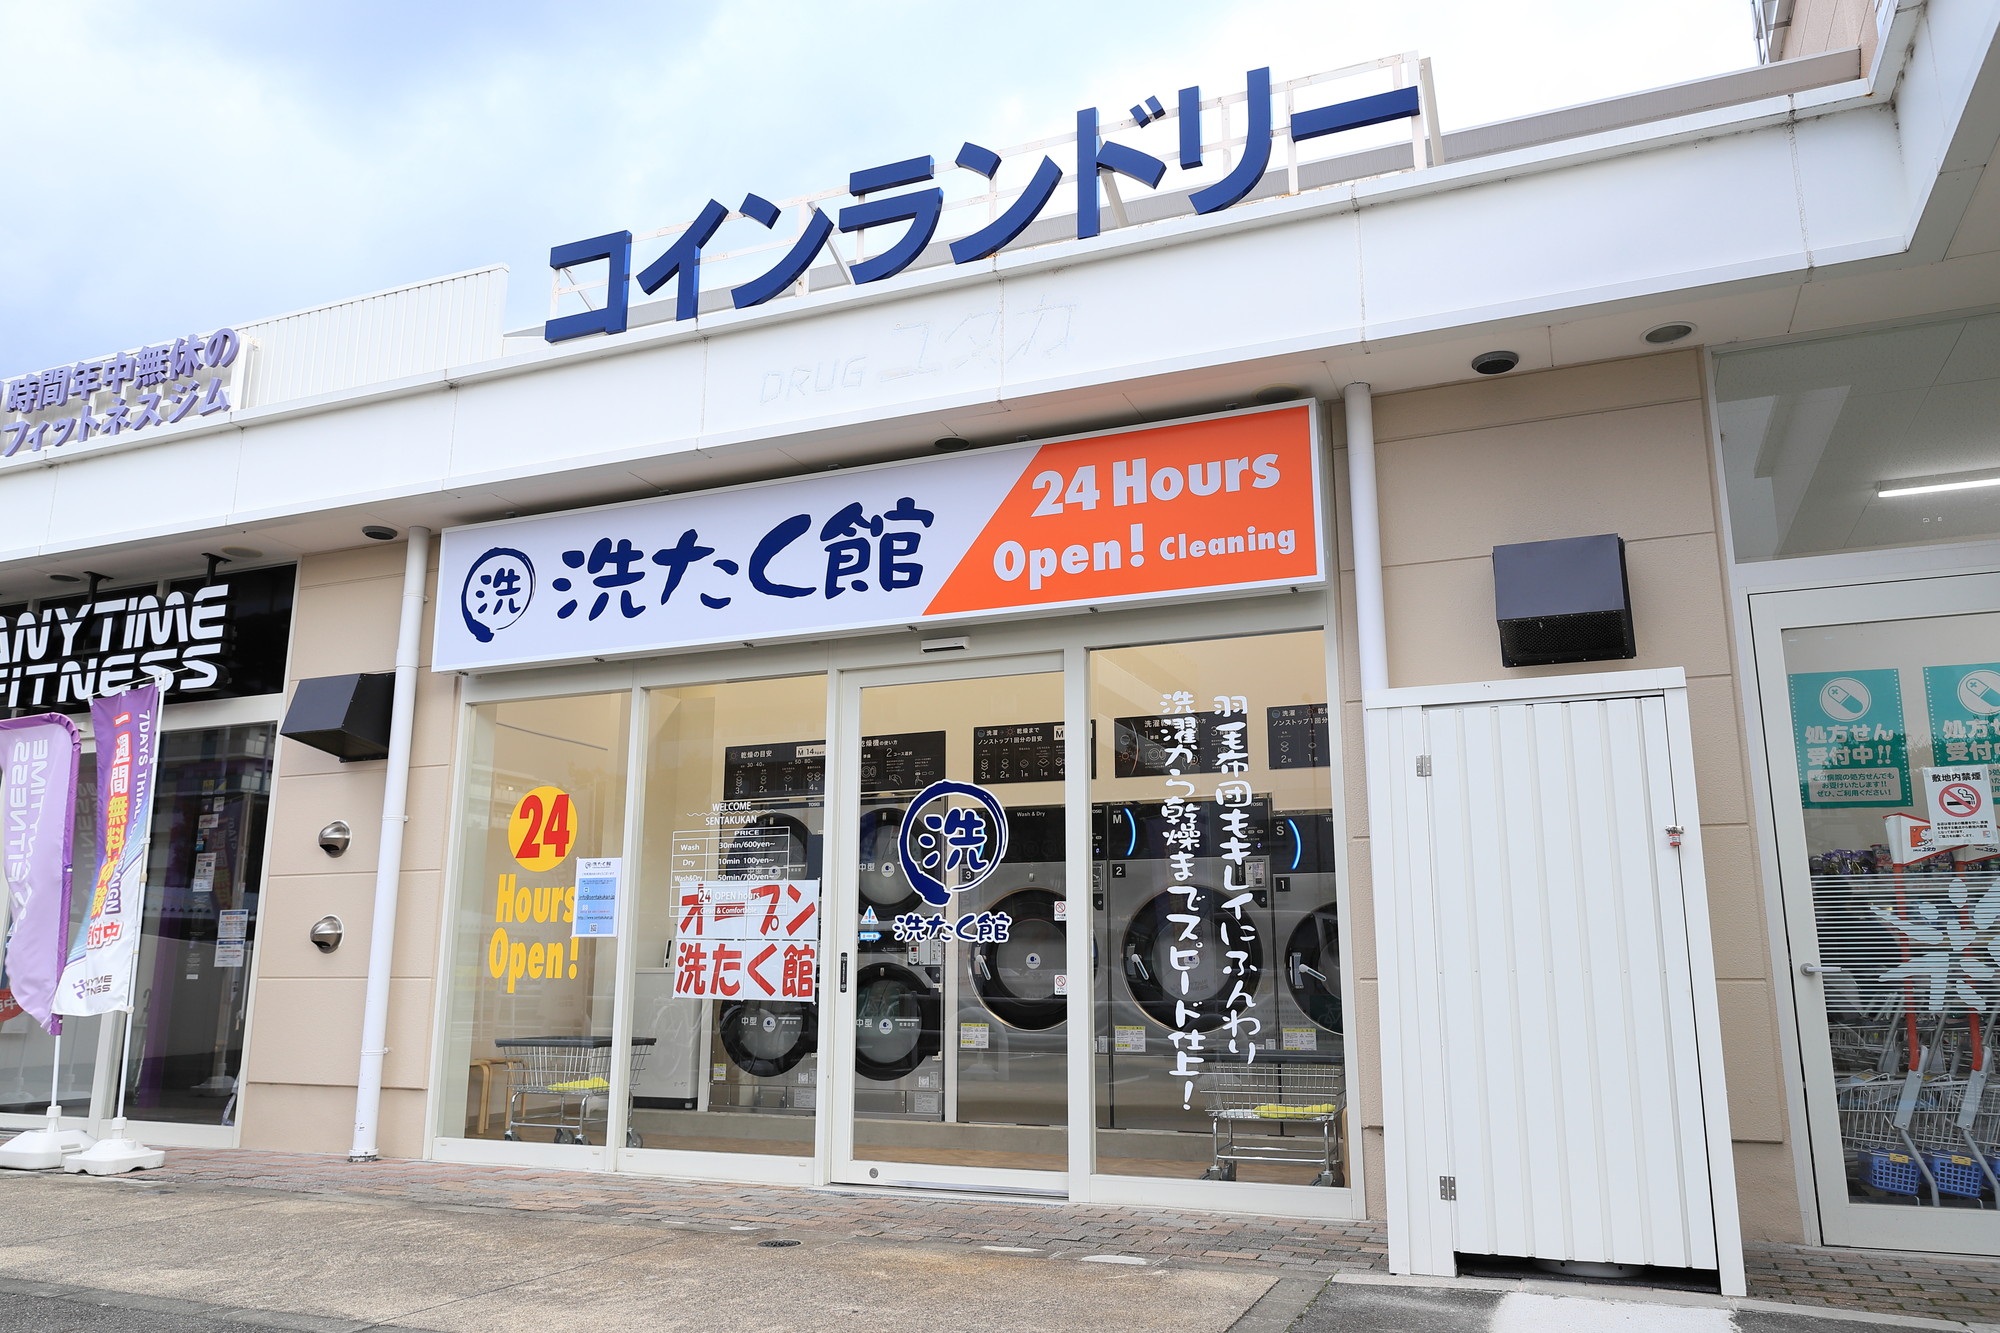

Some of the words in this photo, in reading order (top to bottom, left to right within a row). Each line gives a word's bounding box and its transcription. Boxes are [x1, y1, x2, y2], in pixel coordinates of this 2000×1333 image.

[545, 66, 1420, 342] コインランドリー
[0, 327, 240, 414] 時間年中無休の
[3, 377, 231, 457] フィットネスジム
[1031, 465, 1100, 517] 24
[1113, 453, 1281, 507] Hours
[552, 497, 935, 622] 洗たく館
[993, 523, 1144, 590] Open!
[1159, 526, 1296, 562] Cleaning
[476, 568, 522, 616] 洗
[1056, 730, 1064, 738] M
[1805, 723, 1894, 744] 処方せん
[1931, 771, 1982, 783] 敷地内禁煙
[515, 794, 570, 858] 24
[705, 815, 757, 827] SENTAKUKAN
[712, 801, 751, 812] WELCOME
[1112, 815, 1122, 824] M
[680, 843, 700, 851] Wash
[918, 807, 989, 872] 洗
[1276, 825, 1285, 836] S
[682, 859, 696, 868] Dry
[965, 871, 972, 880] 3
[1115, 866, 1123, 876] 2
[496, 874, 575, 923] Hours
[680, 883, 816, 936] オープン
[699, 890, 711, 903] 24
[714, 891, 737, 900] OPEN
[891, 911, 1014, 943] 洗たく館
[489, 927, 579, 993] Open!
[675, 942, 816, 998] 洗たく館
